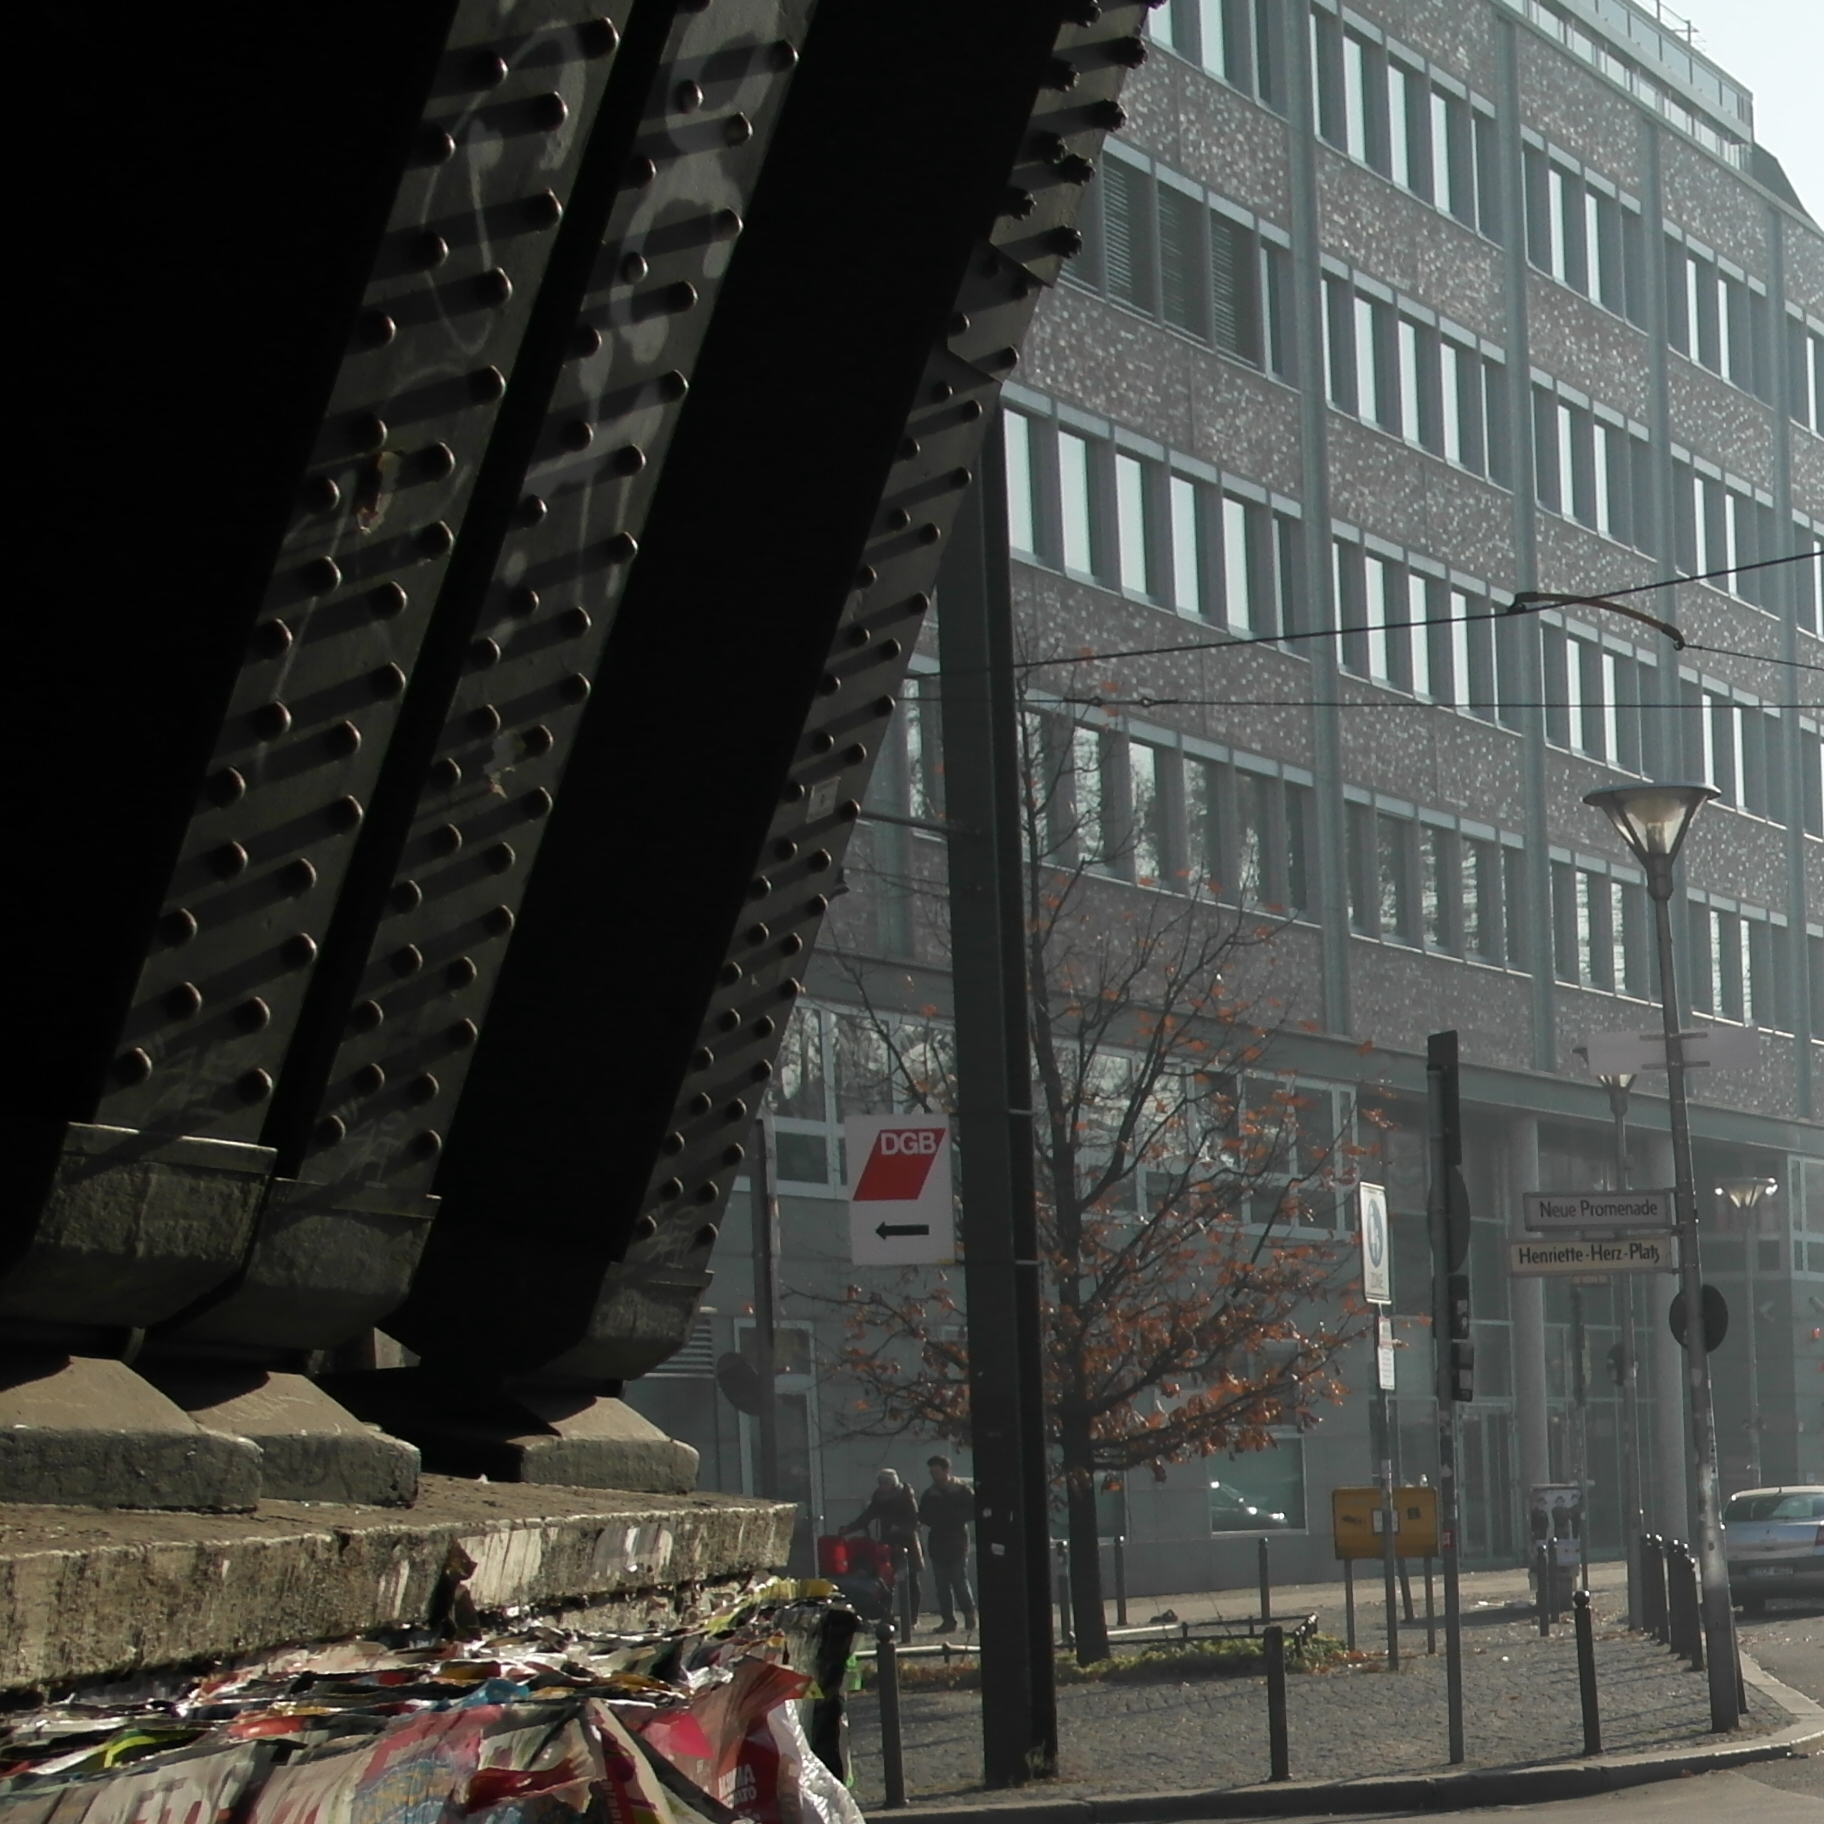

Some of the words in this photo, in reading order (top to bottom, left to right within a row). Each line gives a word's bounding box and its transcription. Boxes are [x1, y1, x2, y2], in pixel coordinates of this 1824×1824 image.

[879, 1130, 938, 1156] DGB
[1539, 1201, 1577, 1218] Neue
[1579, 1198, 1658, 1217] Promenade
